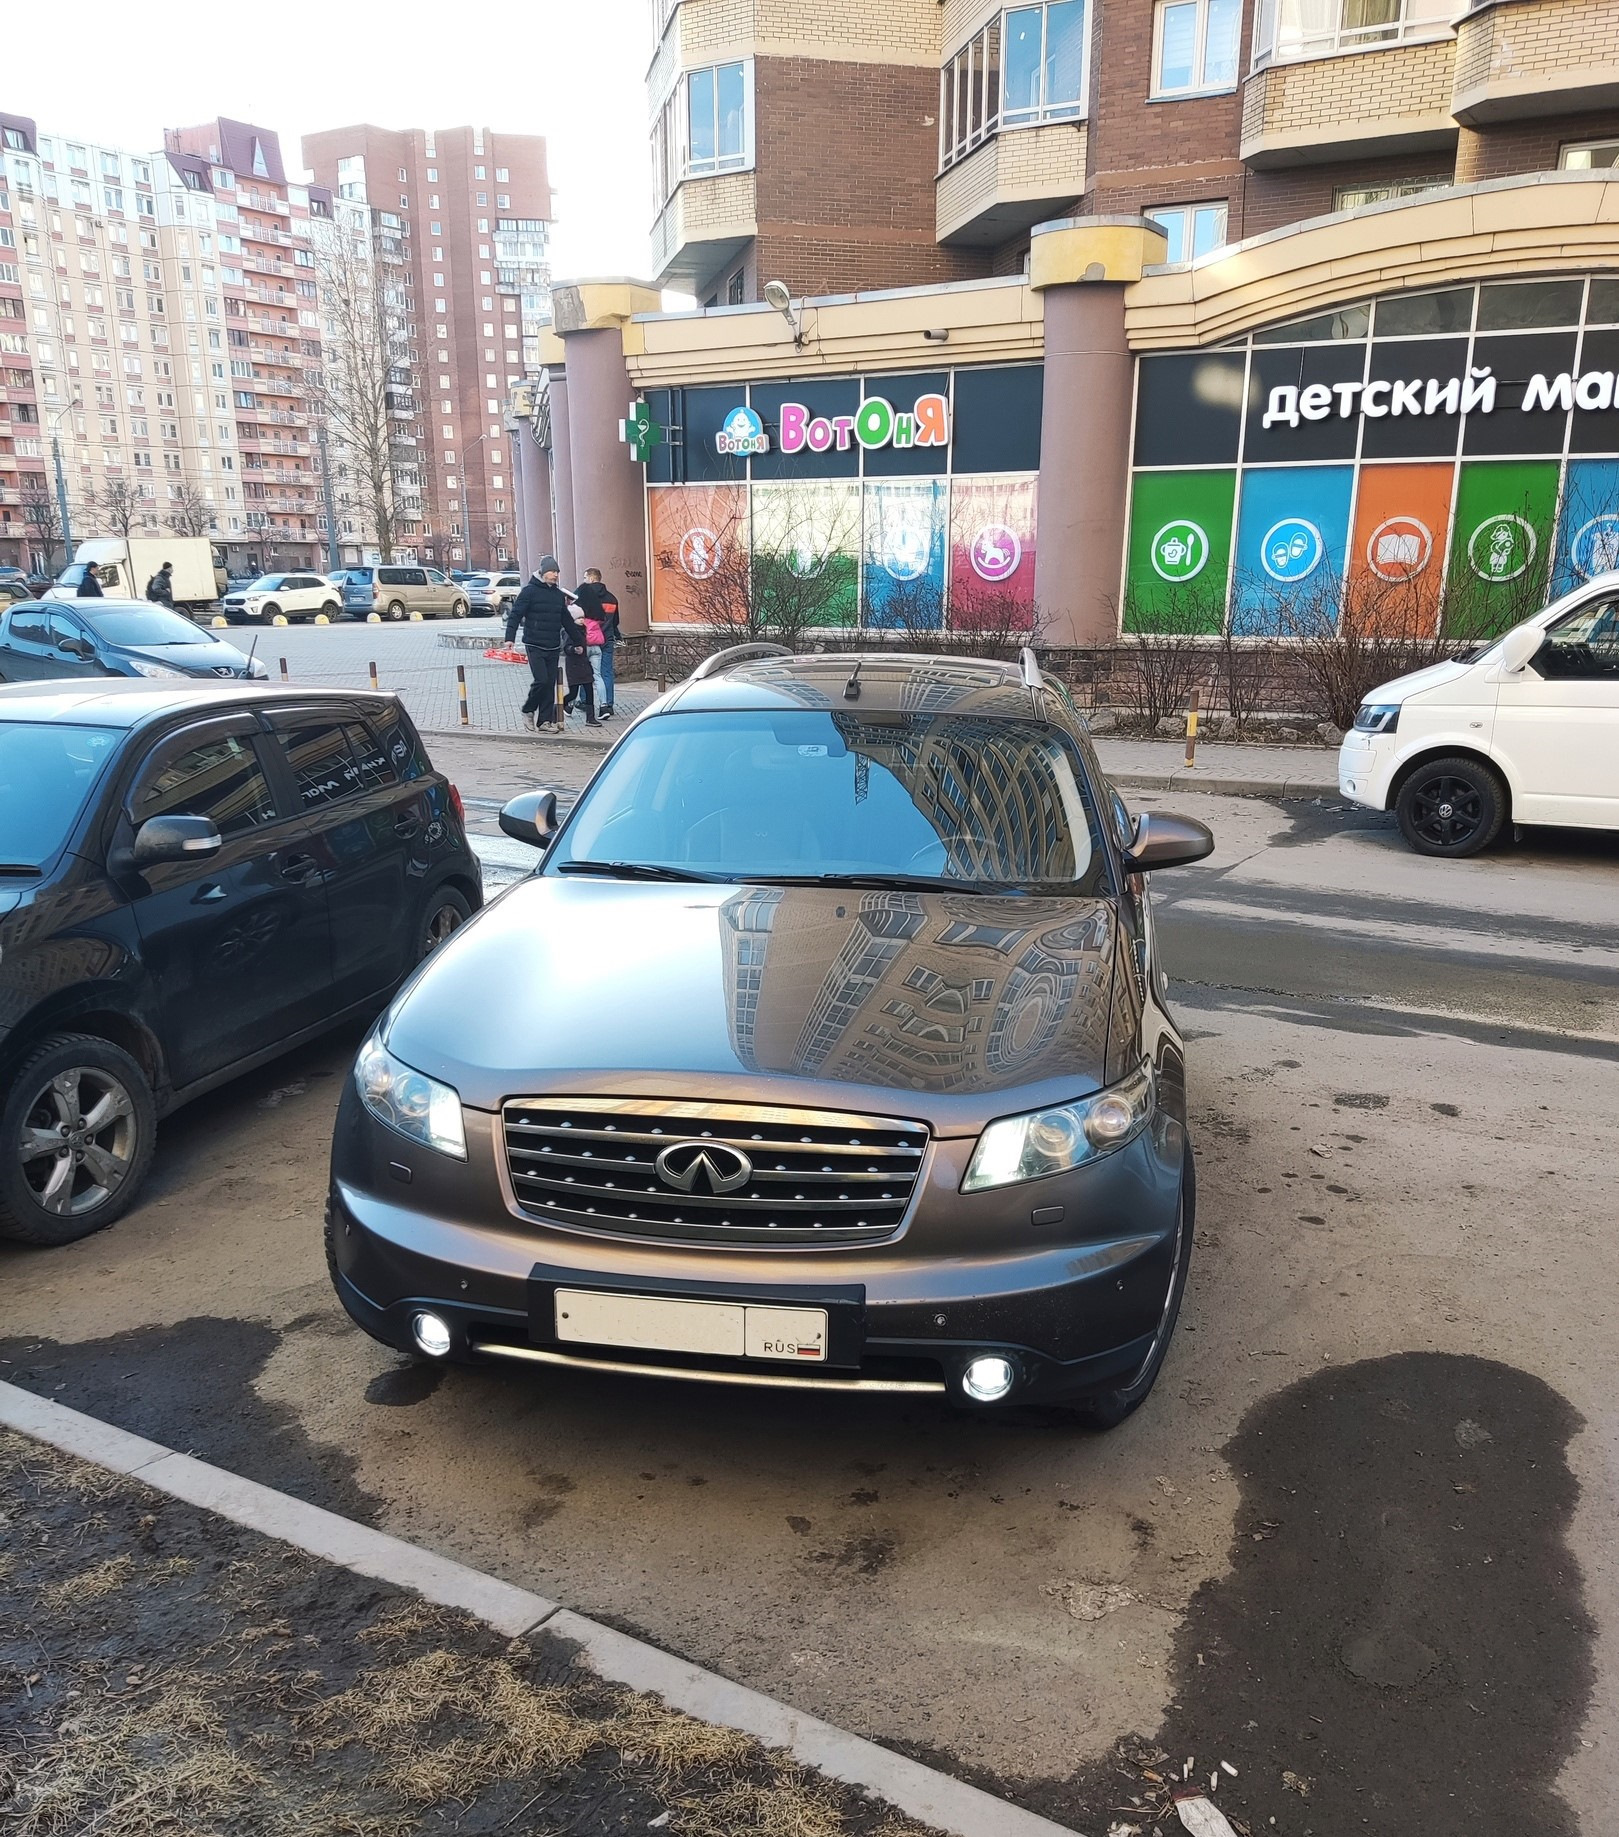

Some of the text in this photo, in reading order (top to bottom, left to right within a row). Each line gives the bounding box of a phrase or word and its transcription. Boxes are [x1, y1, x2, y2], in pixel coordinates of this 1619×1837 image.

[1262, 366, 1619, 430] детский ма
[763, 1342, 796, 1354] RUS
